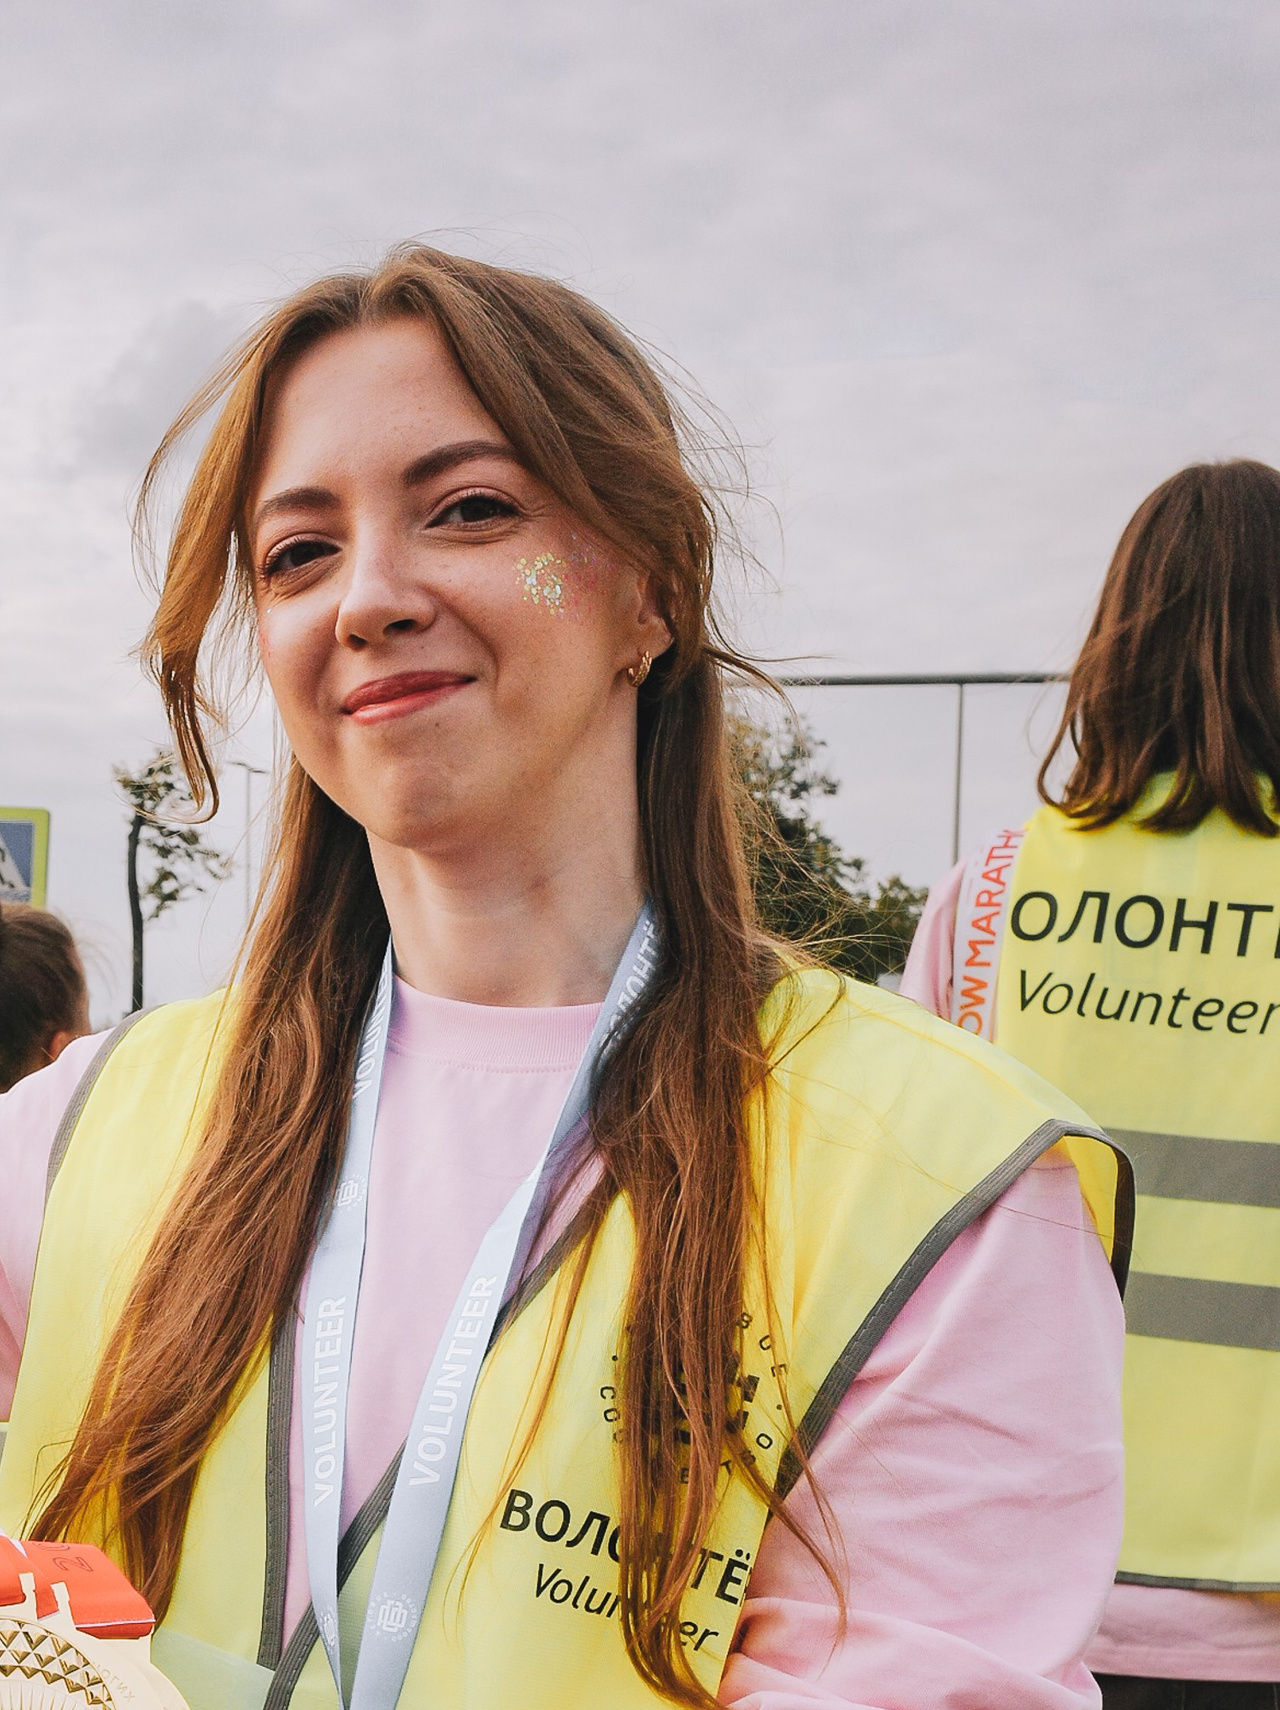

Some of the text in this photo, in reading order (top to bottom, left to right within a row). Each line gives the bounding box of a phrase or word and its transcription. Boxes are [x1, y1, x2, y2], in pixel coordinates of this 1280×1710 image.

[1010, 890, 1280, 959] ОЛОНТ
[1018, 969, 1280, 1035] Volunteer
[313, 1295, 347, 1507] VOLUNTEER
[409, 1274, 497, 1488] VOLUNTEER
